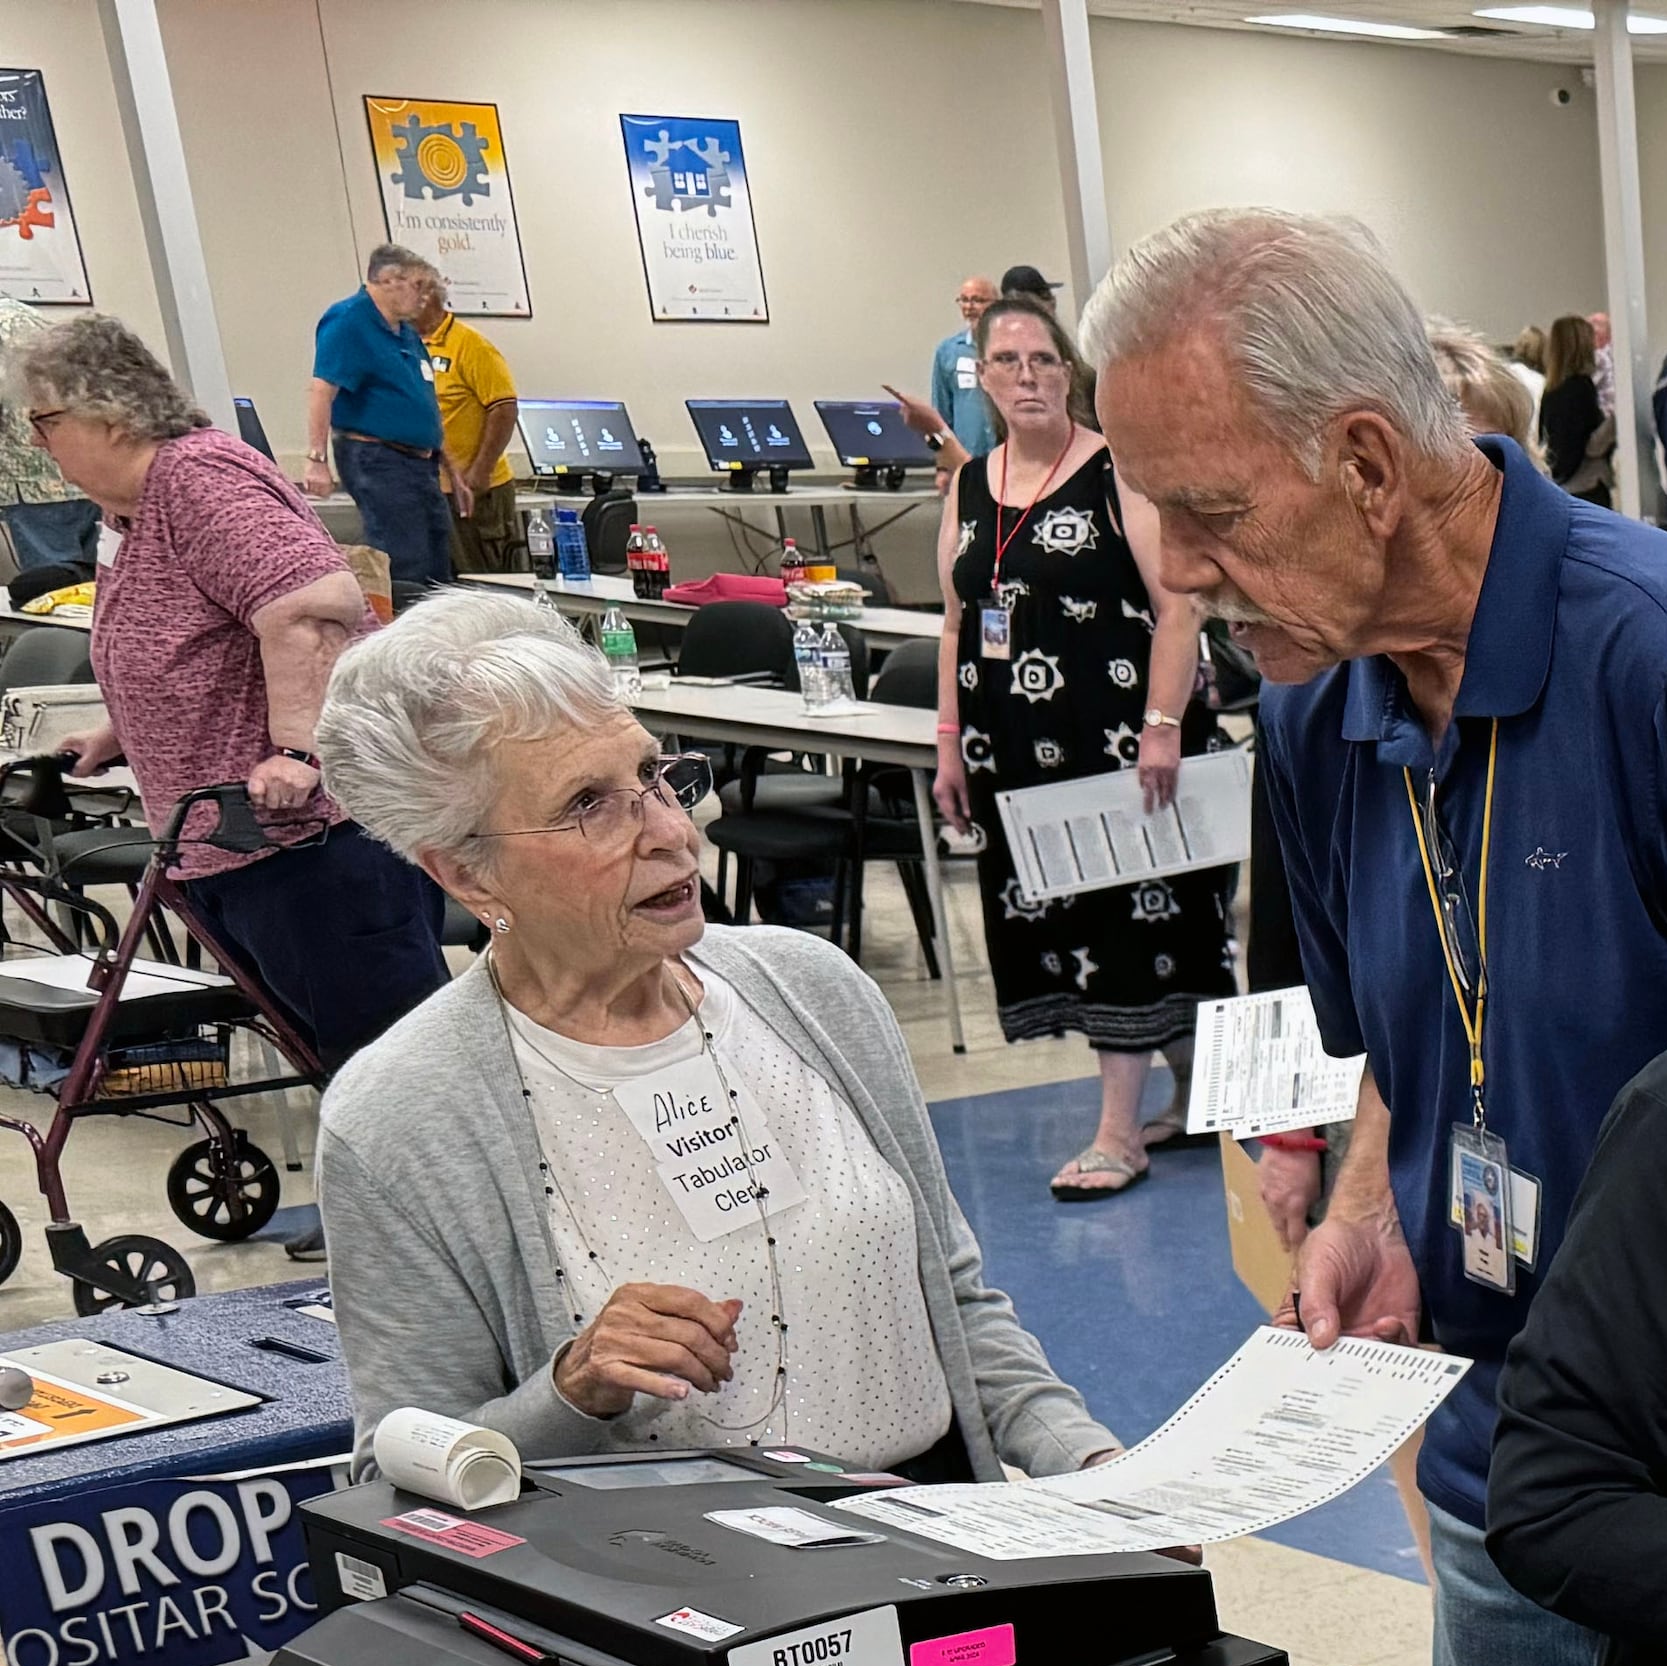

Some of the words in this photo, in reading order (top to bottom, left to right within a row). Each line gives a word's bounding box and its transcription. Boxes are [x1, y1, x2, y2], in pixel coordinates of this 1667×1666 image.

[396, 211, 421, 229] I'm
[425, 213, 507, 237] consistently
[669, 223, 675, 239] I
[679, 223, 728, 241] cherish
[438, 233, 476, 254] gold.
[664, 240, 703, 263] being
[666, 1121, 734, 1157] Visitor
[714, 1185, 766, 1212] Cler
[29, 1478, 292, 1612] DROP
